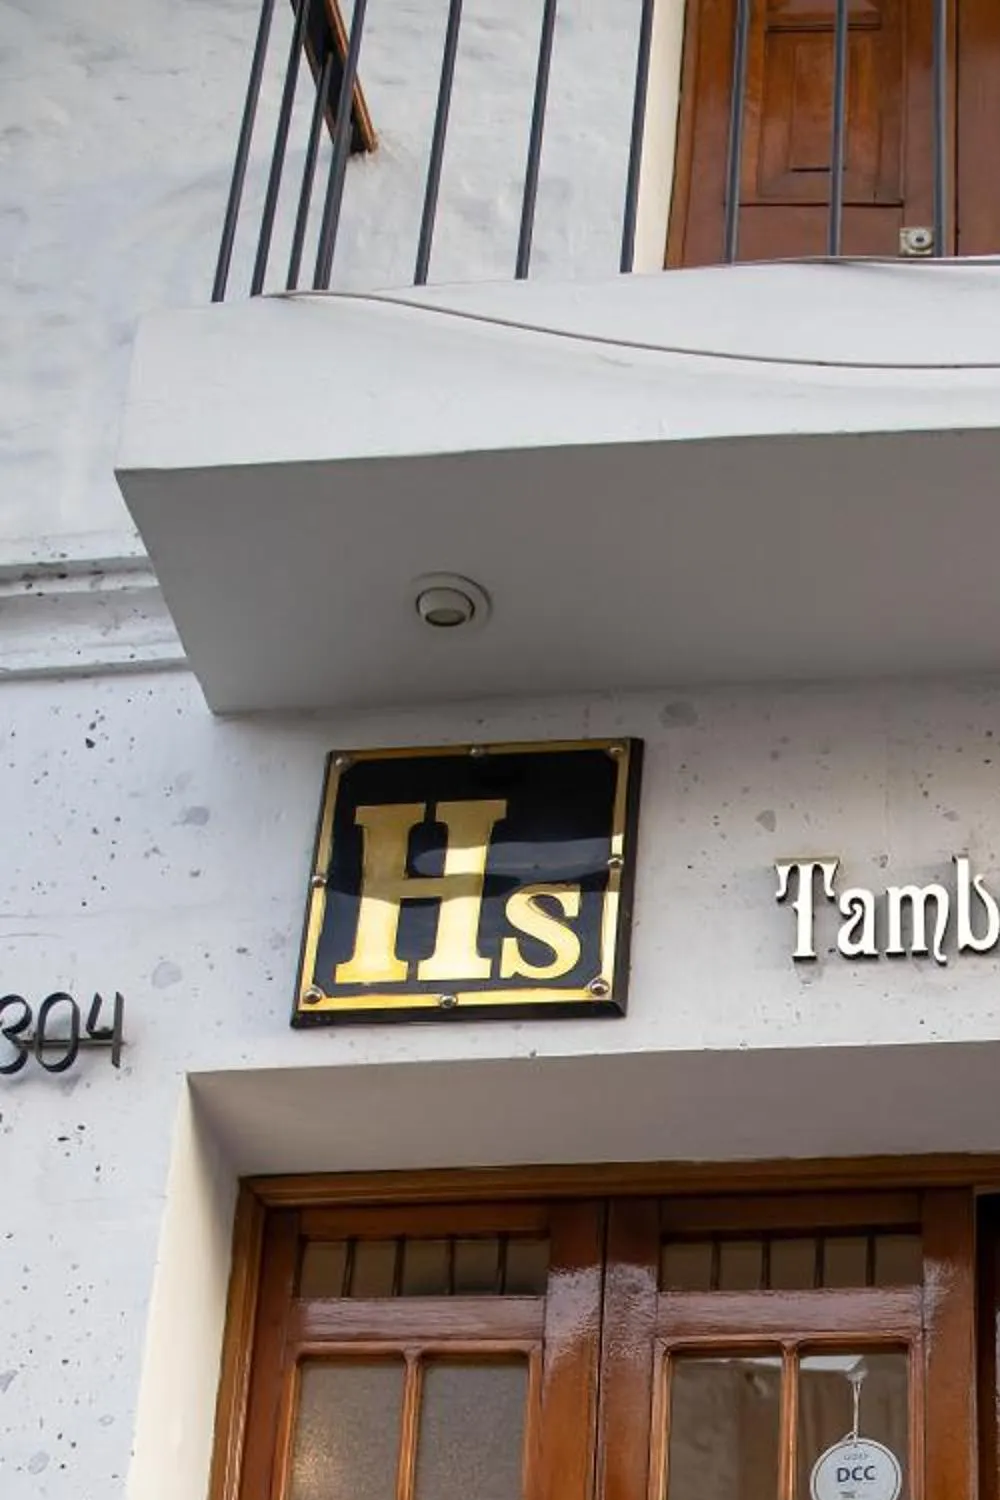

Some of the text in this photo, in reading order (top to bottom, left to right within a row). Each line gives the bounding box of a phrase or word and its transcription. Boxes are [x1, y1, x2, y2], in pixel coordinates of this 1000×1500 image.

[334, 798, 582, 984] Hs
[0, 991, 125, 1075] 304
[836, 1465, 877, 1483] DCC
